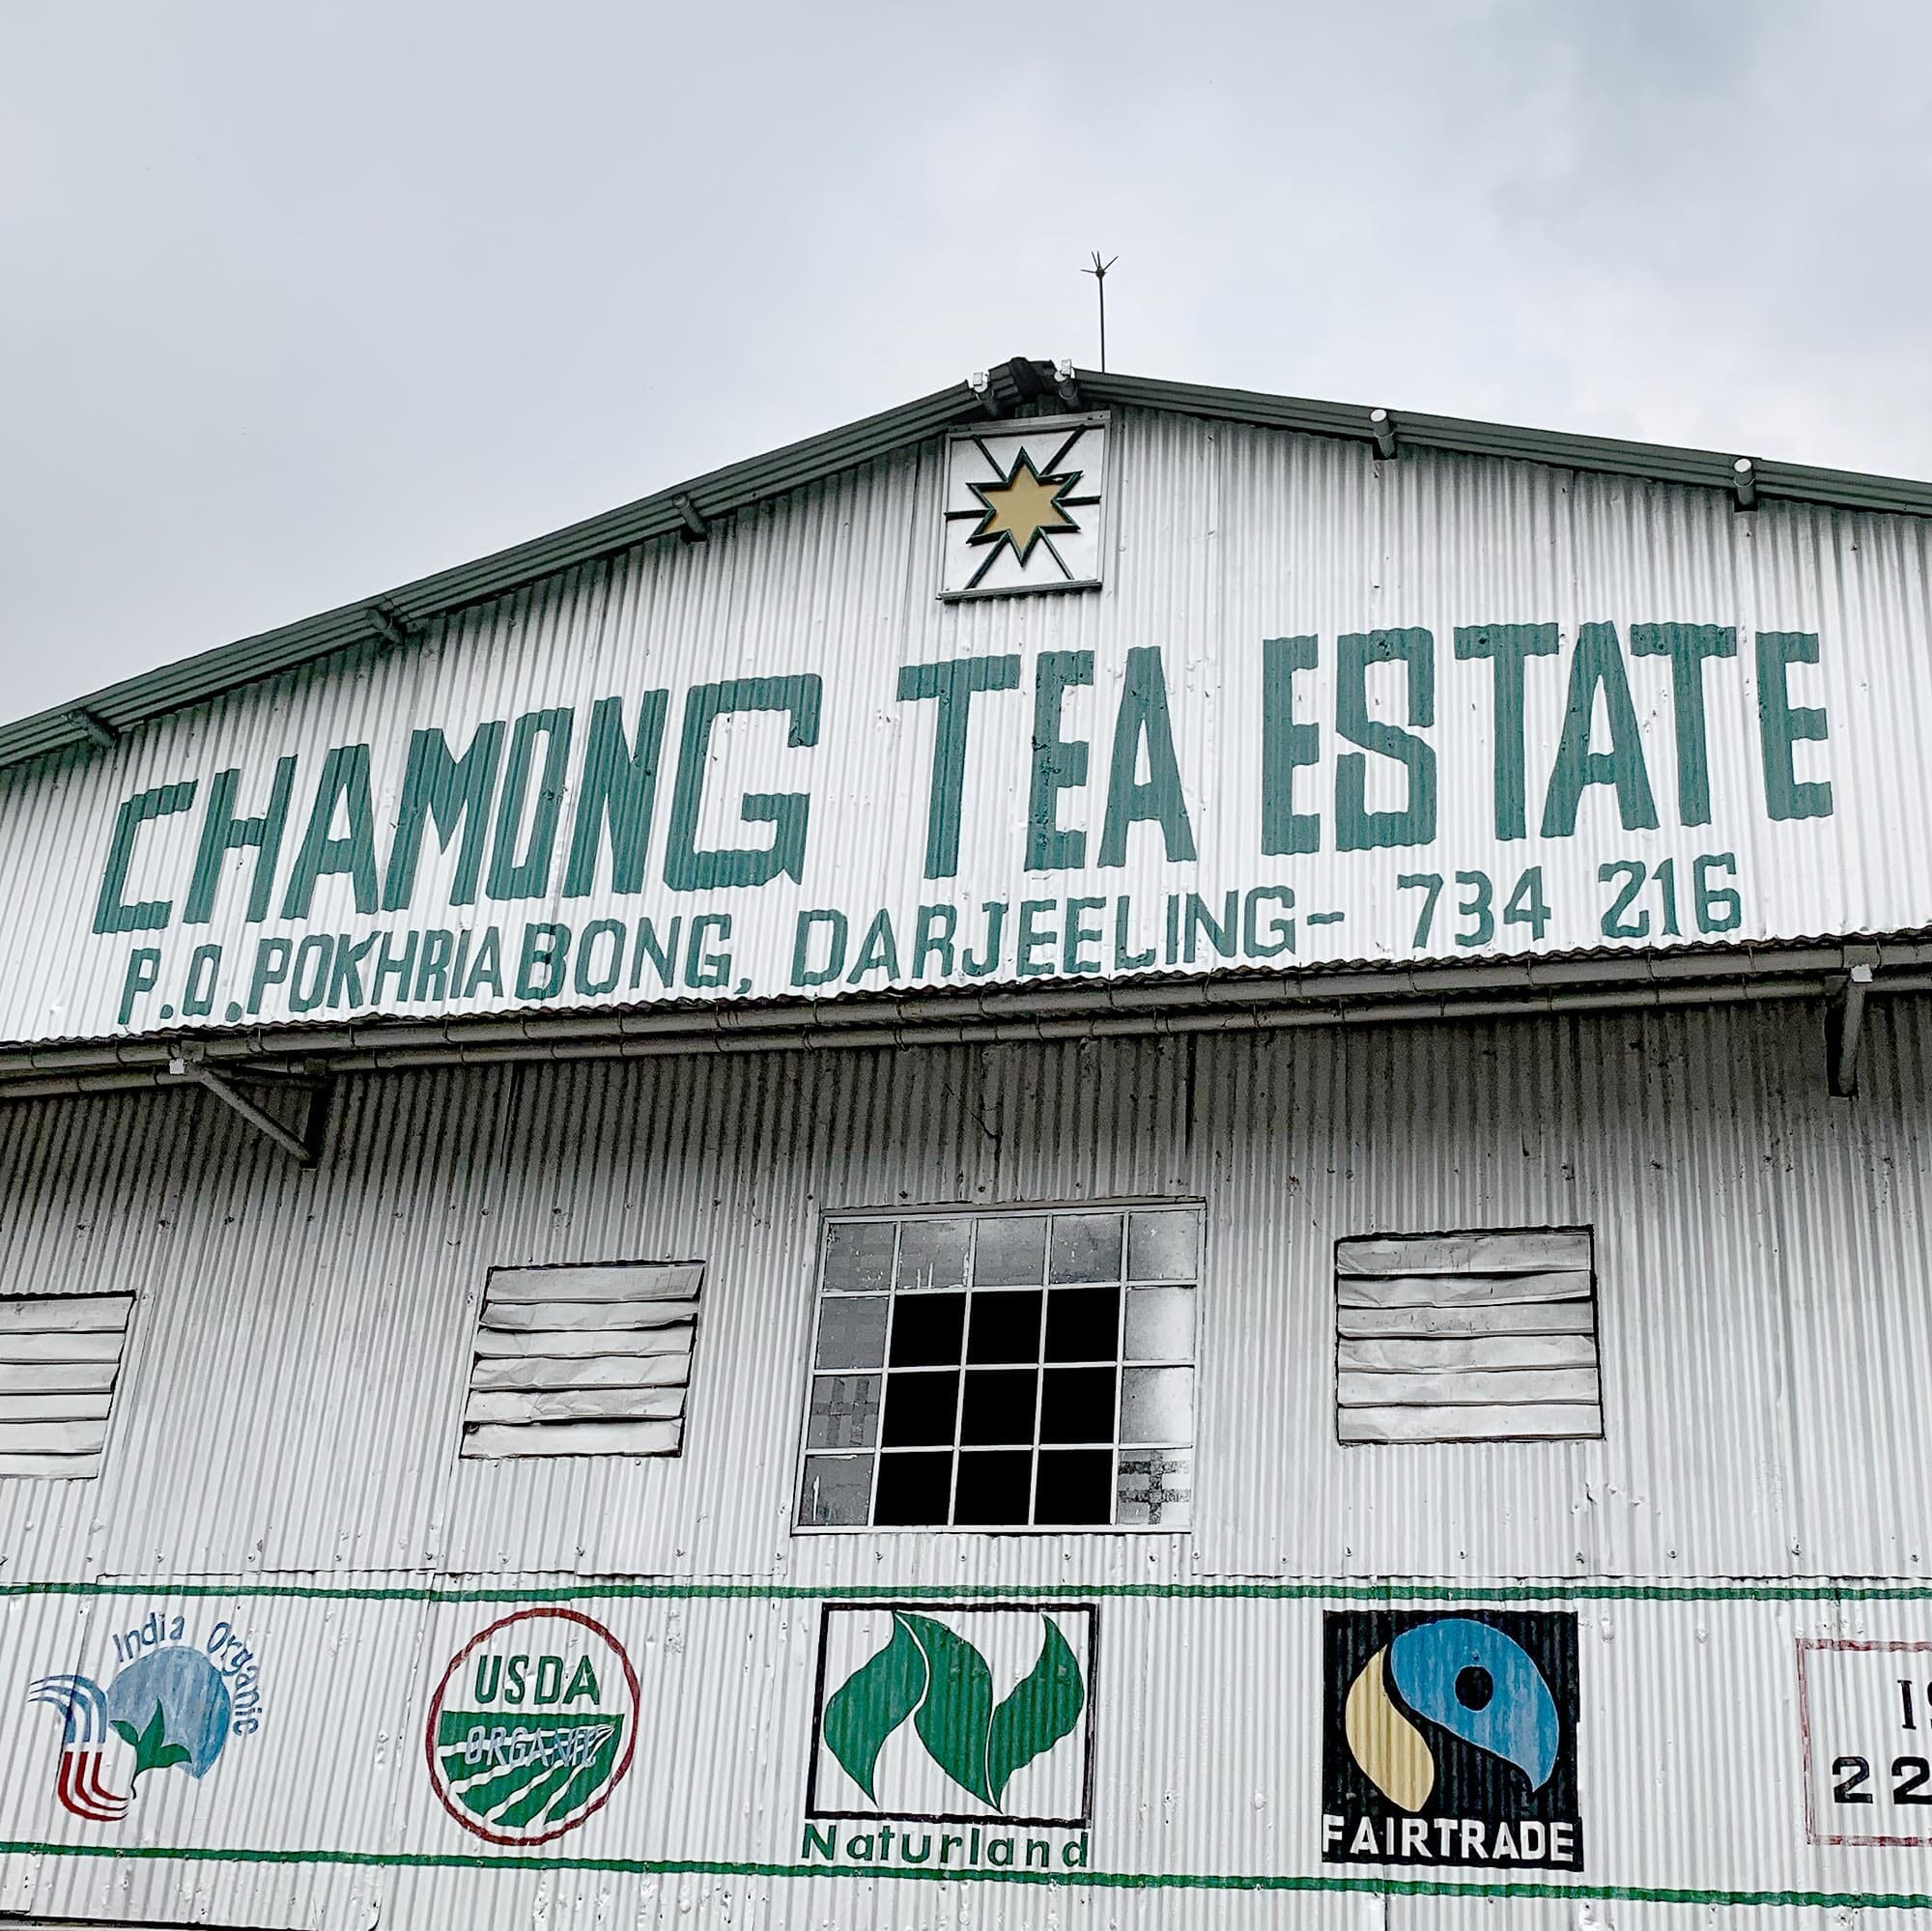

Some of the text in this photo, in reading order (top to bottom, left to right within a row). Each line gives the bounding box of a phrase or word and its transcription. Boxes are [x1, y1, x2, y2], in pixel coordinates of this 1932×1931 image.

[93, 620, 1834, 934] CHAMONG TEA ESTATE
[246, 912, 753, 1015] POKHRIABONG,
[1396, 867, 1551, 949] 734
[1599, 852, 1742, 939] 216
[113, 1610, 265, 1738] India Organic
[475, 1653, 601, 1706] USDA
[1896, 1679, 1932, 1731] I
[464, 1724, 598, 1768] ORGANIC
[801, 1823, 1089, 1868] Naturland
[1322, 1815, 1575, 1862] FAIRTRADE
